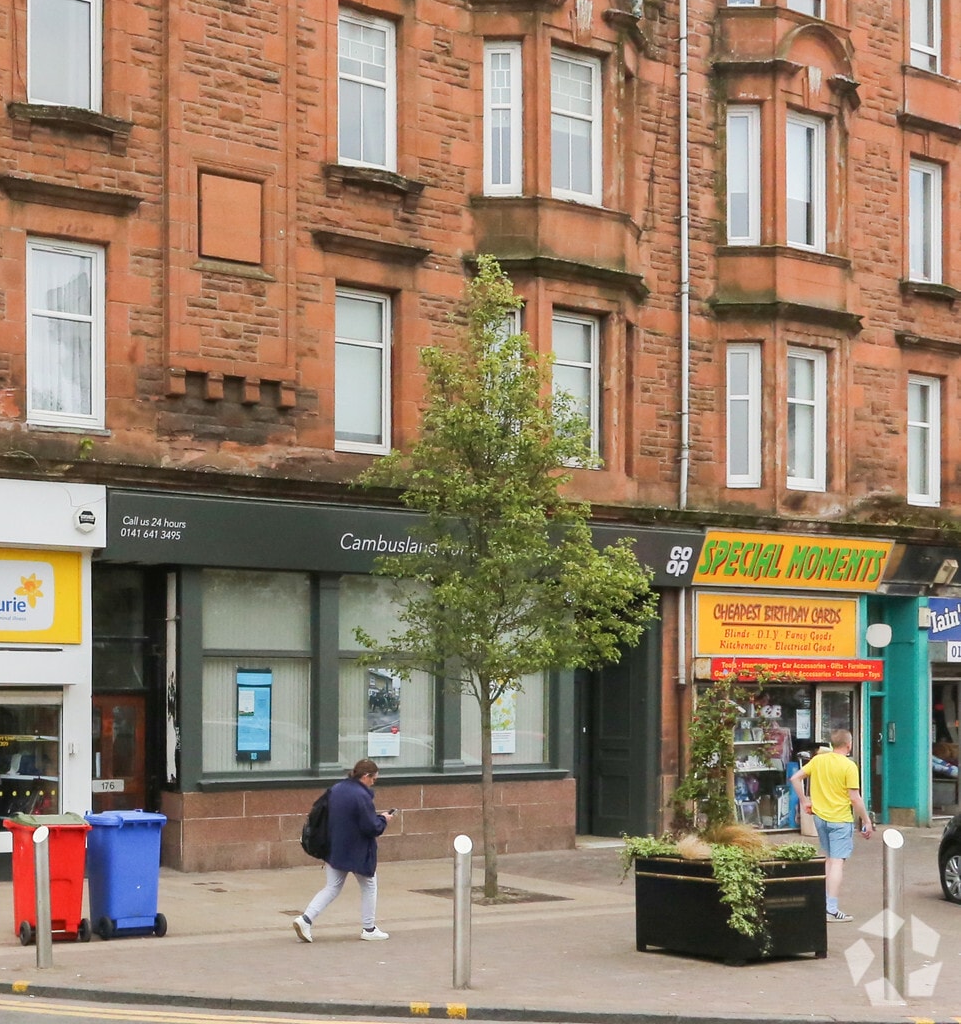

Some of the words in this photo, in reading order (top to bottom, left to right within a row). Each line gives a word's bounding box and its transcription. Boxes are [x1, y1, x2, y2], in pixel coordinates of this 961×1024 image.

[122, 515, 139, 526] Call
[139, 519, 150, 527] us
[151, 517, 162, 527] 24
[163, 518, 187, 529] hours
[120, 528, 141, 538] 0141
[143, 529, 158, 539] 641
[160, 530, 181, 540] 3495
[698, 539, 784, 581] SPECIAL
[785, 545, 887, 582] MOMENTS
[713, 603, 762, 621] CHEAPEST
[764, 605, 809, 622] BIRTHDAY
[811, 606, 842, 625] CARDS
[724, 628, 750, 638] Blinds
[785, 630, 808, 641] Fancy
[810, 631, 832, 641] Goods
[719, 639, 767, 650] Kitchenware
[775, 641, 811, 651] Electrical
[813, 642, 835, 653] Goods
[101, 781, 115, 790] 176
